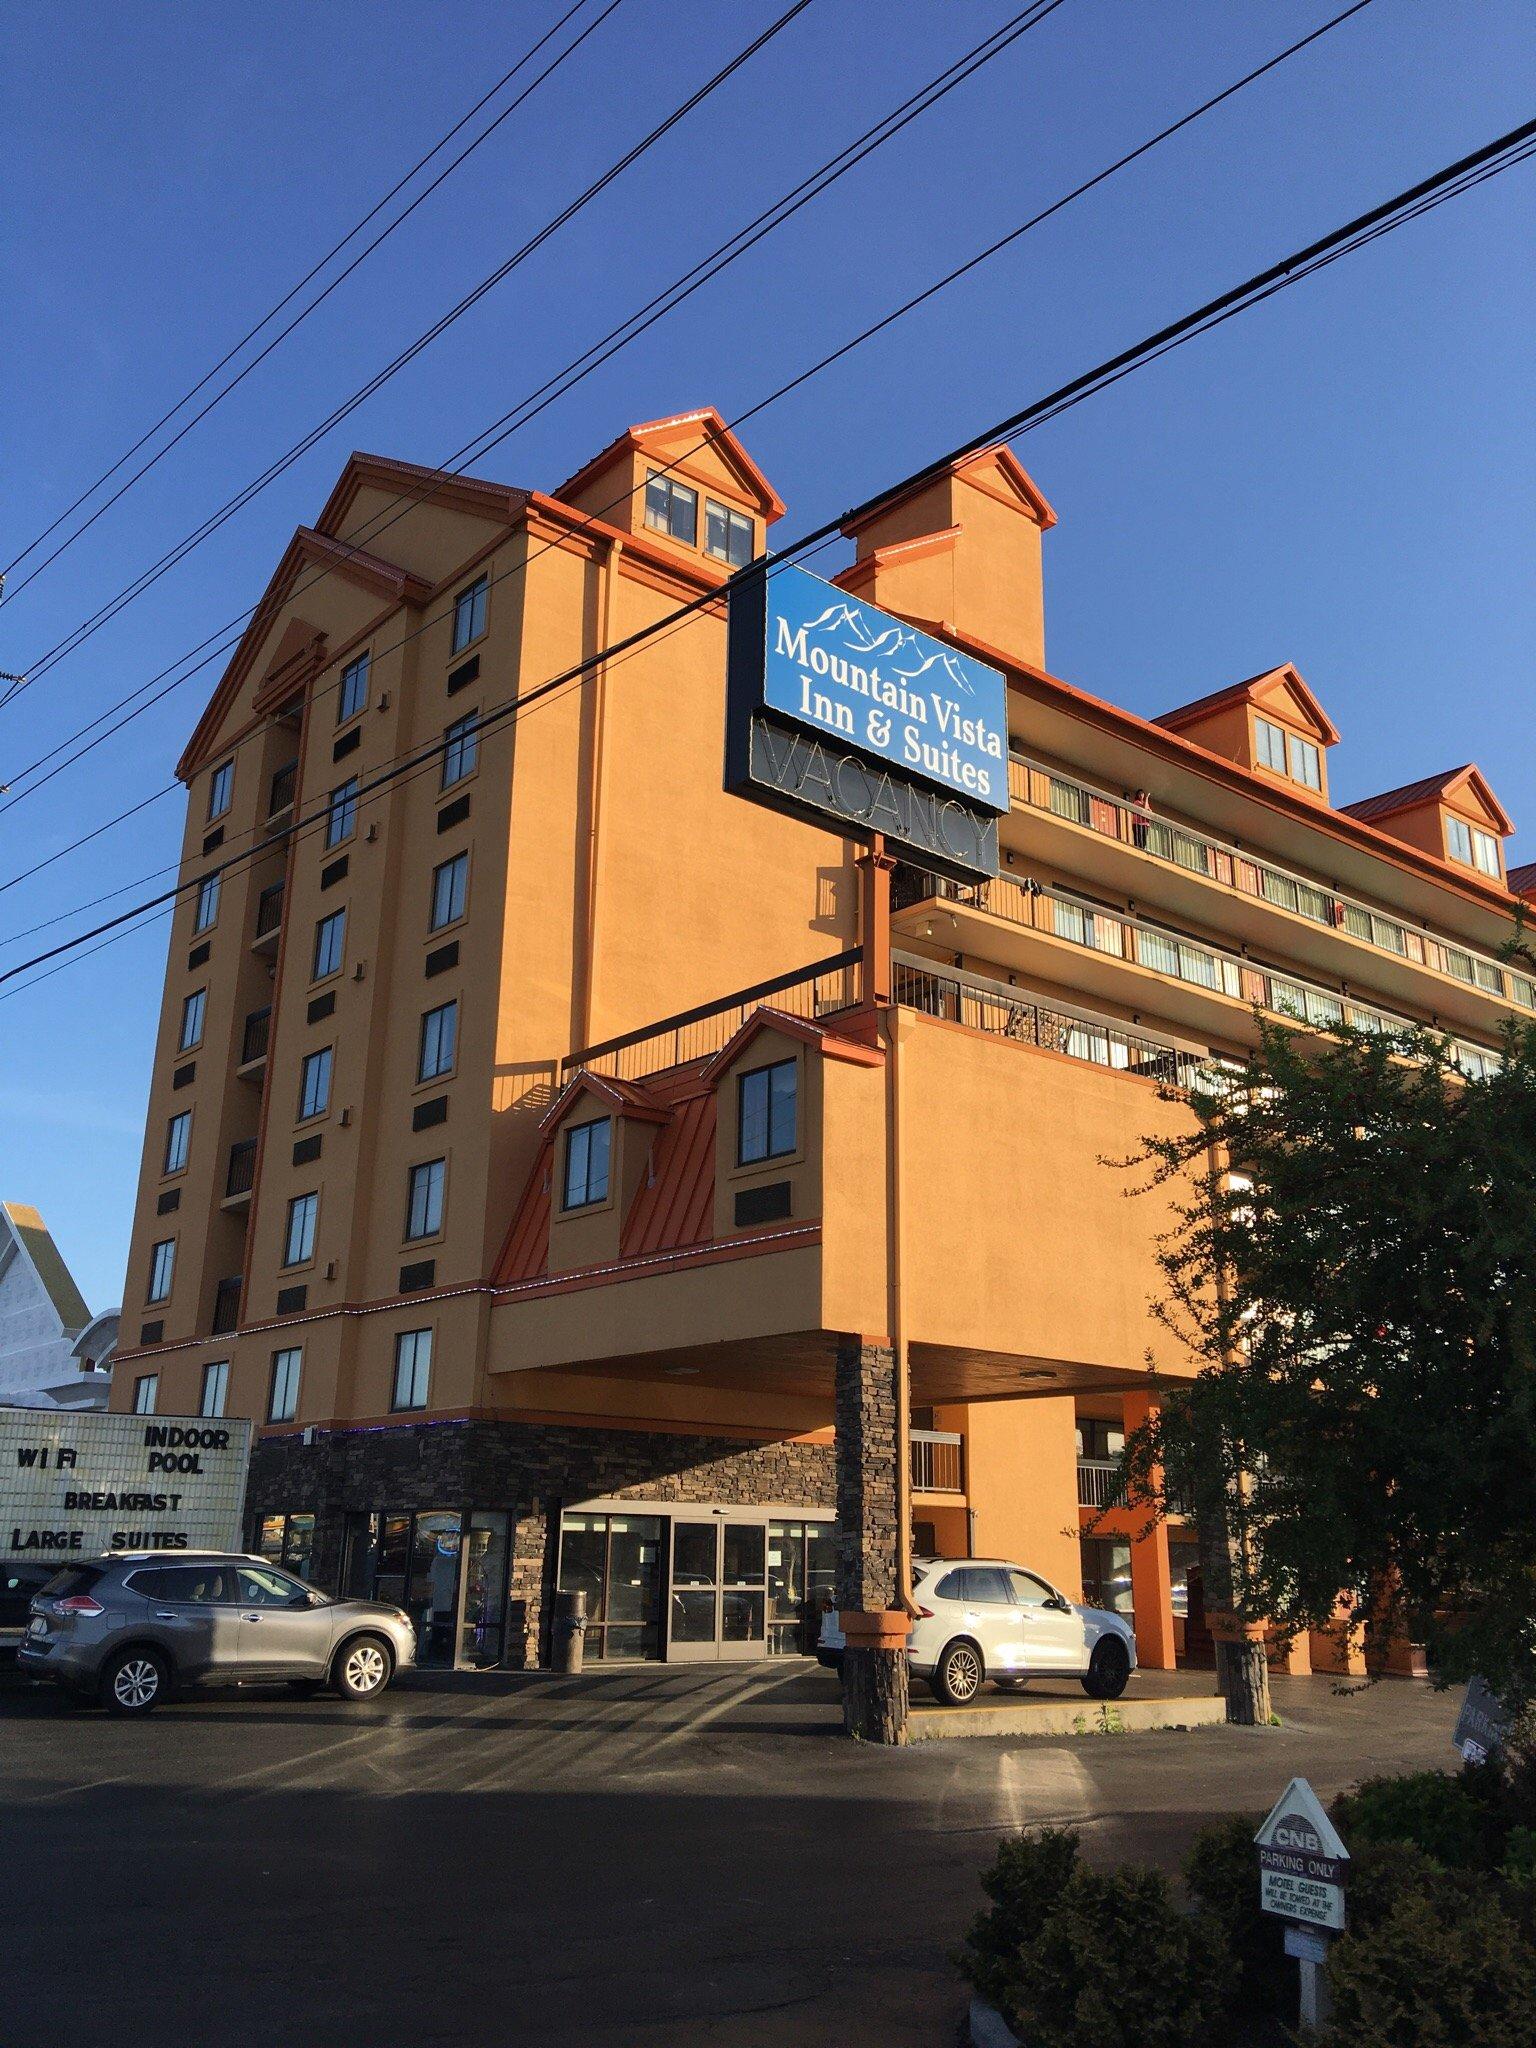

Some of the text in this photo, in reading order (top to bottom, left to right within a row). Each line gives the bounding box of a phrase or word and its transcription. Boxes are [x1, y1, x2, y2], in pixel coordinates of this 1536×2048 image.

[774, 615, 1002, 760] Mountain Vista
[799, 674, 991, 796] Inn & Suites
[758, 716, 996, 866] VACANCY
[144, 1425, 230, 1450] INDOOR
[147, 1452, 204, 1475] POOL
[64, 1491, 183, 1512] BREAKFAST
[11, 1528, 189, 1551] LARGE SUITES
[1276, 1827, 1319, 1851] CNB
[1260, 1850, 1335, 1879] PARKING ONLY
[1268, 1875, 1327, 1898] MOTEL GUESTS
[1265, 1887, 1333, 1911] WILL BE TOWED AT THE
[1299, 1906, 1328, 1920] EXPENSE
